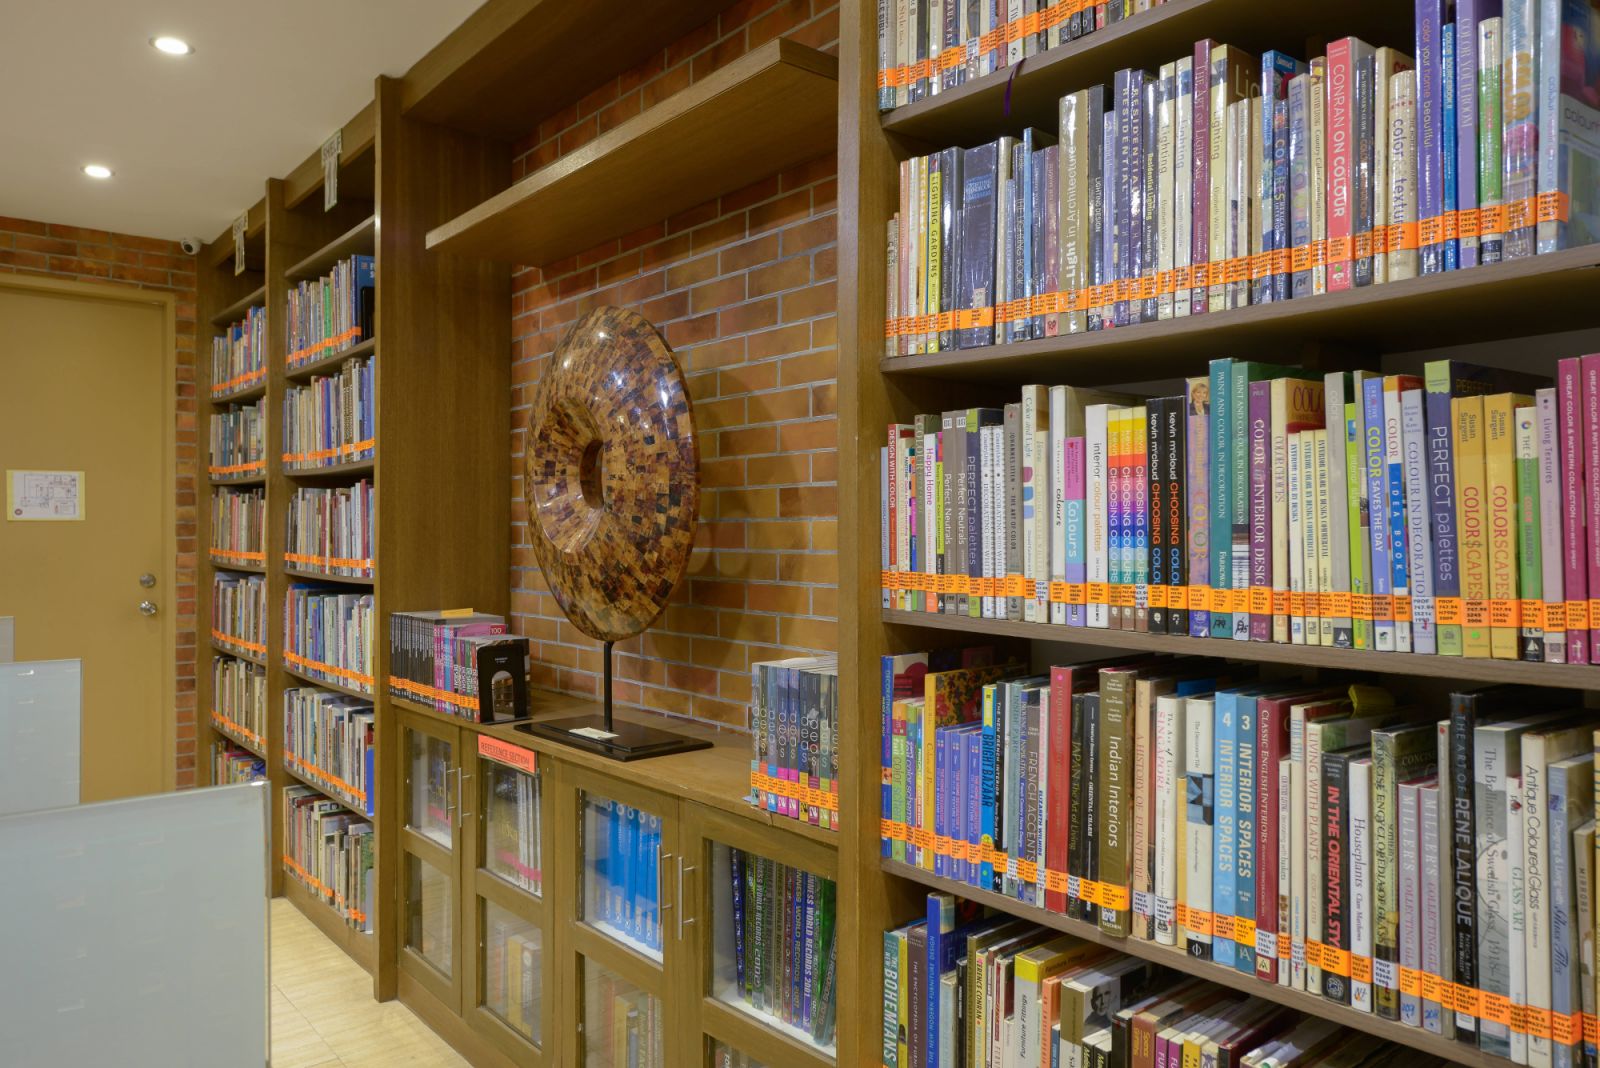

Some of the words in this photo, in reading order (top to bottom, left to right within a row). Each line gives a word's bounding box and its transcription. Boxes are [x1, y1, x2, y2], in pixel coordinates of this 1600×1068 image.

[1423, 18, 1432, 43] color
[1461, 19, 1471, 57] COLOR
[1422, 46, 1431, 65] your
[1196, 64, 1205, 86] THE
[1423, 69, 1432, 98] home
[1195, 90, 1206, 110] ART
[1291, 81, 1303, 112] THE
[1333, 64, 1344, 127] CONRAN
[1462, 94, 1472, 127] ROOM
[1195, 113, 1202, 124] OF
[1292, 117, 1304, 155] NEW
[1423, 101, 1433, 148] beautiful
[1314, 130, 1323, 154] Country
[1334, 131, 1344, 153] ON
[1393, 119, 1406, 156] color
[1067, 146, 1076, 220] Architecture
[1315, 179, 1324, 222] Combinations
[1334, 157, 1345, 217] COLOUR
[1067, 227, 1076, 238] in
[1016, 260, 1024, 285] BOOK
[1066, 243, 1076, 277] Light
[1218, 371, 1226, 396] PAINT
[1025, 397, 1033, 419] Color
[1218, 399, 1226, 416] AND
[1490, 409, 1499, 440] Sargent
[1025, 422, 1033, 435] and
[1217, 419, 1226, 448] COLOR
[1387, 418, 1398, 457] COLOR
[1460, 413, 1469, 442] Sargent
[1468, 415, 1476, 438] Susan
[1543, 418, 1552, 444] Living
[925, 448, 934, 477] Happy
[1025, 438, 1033, 457] Light
[1218, 452, 1226, 461] IN
[1367, 427, 1381, 477] COLOR
[1432, 426, 1450, 506] PERFECT
[1545, 447, 1554, 484] Textures
[926, 479, 934, 505] Home
[944, 473, 952, 505] Perfect
[958, 473, 966, 504] Perfect
[967, 456, 976, 513] PERFECT
[1123, 466, 1131, 526] CHOOSING
[1136, 465, 1144, 525] CHOOSING
[1218, 464, 1226, 518] DECORATION
[1372, 480, 1381, 509] SAVES
[1392, 481, 1400, 516] IDEA
[944, 508, 952, 545] Neutrals
[958, 508, 966, 545] Neutrals
[1068, 501, 1079, 557] Colours
[1092, 513, 1101, 551] palettes
[1152, 483, 1161, 544] CHOOSING
[1170, 483, 1179, 544] CHOOSING
[1373, 512, 1382, 530] THE
[967, 516, 977, 565] palettes
[1123, 530, 1131, 582] COLOURS
[1136, 530, 1144, 583] COLOURS
[1374, 532, 1383, 552] DAY
[1394, 530, 1403, 570] BOOK
[1436, 513, 1456, 580] palettes
[1464, 487, 1483, 599] COLORSCAPES
[1493, 485, 1511, 600] COLORSCAPES
[1152, 549, 1161, 585] COLOU
[1171, 548, 1179, 585] COLOU
[1223, 713, 1231, 727] 4
[1241, 715, 1250, 731] 3
[1261, 710, 1269, 748] CLASSIC
[1456, 716, 1465, 739] THE
[982, 734, 993, 768] BRIGHT
[1072, 742, 1080, 779] JAPAN
[1109, 736, 1121, 780] Indian
[1136, 745, 1144, 790] HISTORY
[1157, 711, 1165, 792] SINGAPORE
[1309, 733, 1319, 773] LIVING
[1456, 745, 1465, 768] ART
[1485, 749, 1495, 768] The
[982, 769, 993, 807] BAZAAR
[1027, 752, 1037, 800] FRENCH
[1220, 739, 1232, 808] INTERIOR
[1240, 743, 1252, 811] INTERIOR
[1261, 750, 1269, 791] ENGLISH
[1457, 773, 1466, 792] OF
[1071, 800, 1079, 813] Art
[1072, 783, 1080, 797] The
[1136, 796, 1144, 808] OF
[1309, 779, 1319, 812] WITH
[1328, 786, 1339, 803] IN
[1485, 775, 1497, 829] Brilliance
[1525, 766, 1539, 813] Antique
[1027, 805, 1037, 862] ACCENTS
[1070, 815, 1078, 823] of
[1108, 785, 1121, 847] Interiors
[1260, 793, 1269, 843] INTERIORS
[1328, 807, 1339, 836] THE
[1455, 798, 1470, 843] RENE
[1069, 825, 1078, 850] Living
[1135, 816, 1144, 881] FURNITURE
[1220, 815, 1232, 871] SPACES
[1239, 820, 1252, 877] SPACES
[1309, 816, 1319, 860] PLANTS
[1352, 818, 1365, 887] Houseplants
[1485, 833, 1498, 843] of
[1527, 816, 1541, 875] Coloured
[1328, 840, 1340, 914] ORIENTAL
[1455, 848, 1471, 926] LALIQUE
[1486, 850, 1499, 894] Swedish
[1512, 867, 1523, 904] GLASS
[1579, 868, 1588, 913] MIRRORS
[1529, 877, 1542, 909] Glass
[1328, 920, 1340, 948] STY
[1513, 907, 1523, 933] ART
[884, 968, 897, 1061] BOHEMIANS
[913, 1034, 918, 1043] OF
